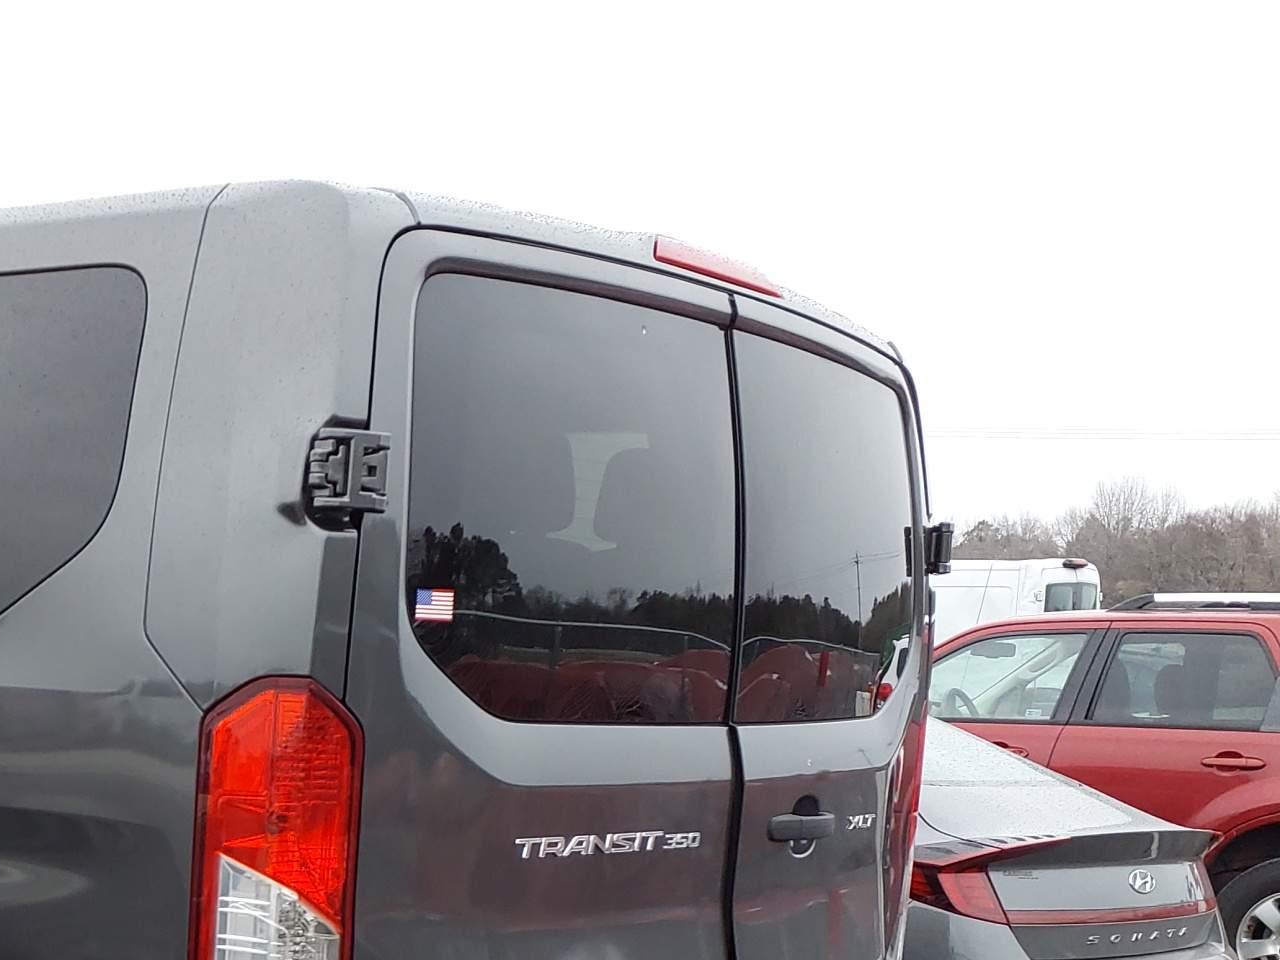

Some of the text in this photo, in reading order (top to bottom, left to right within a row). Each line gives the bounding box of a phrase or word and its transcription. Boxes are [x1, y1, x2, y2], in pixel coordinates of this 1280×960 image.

[846, 813, 876, 830] XLT
[515, 831, 701, 859] TRANSIT 350
